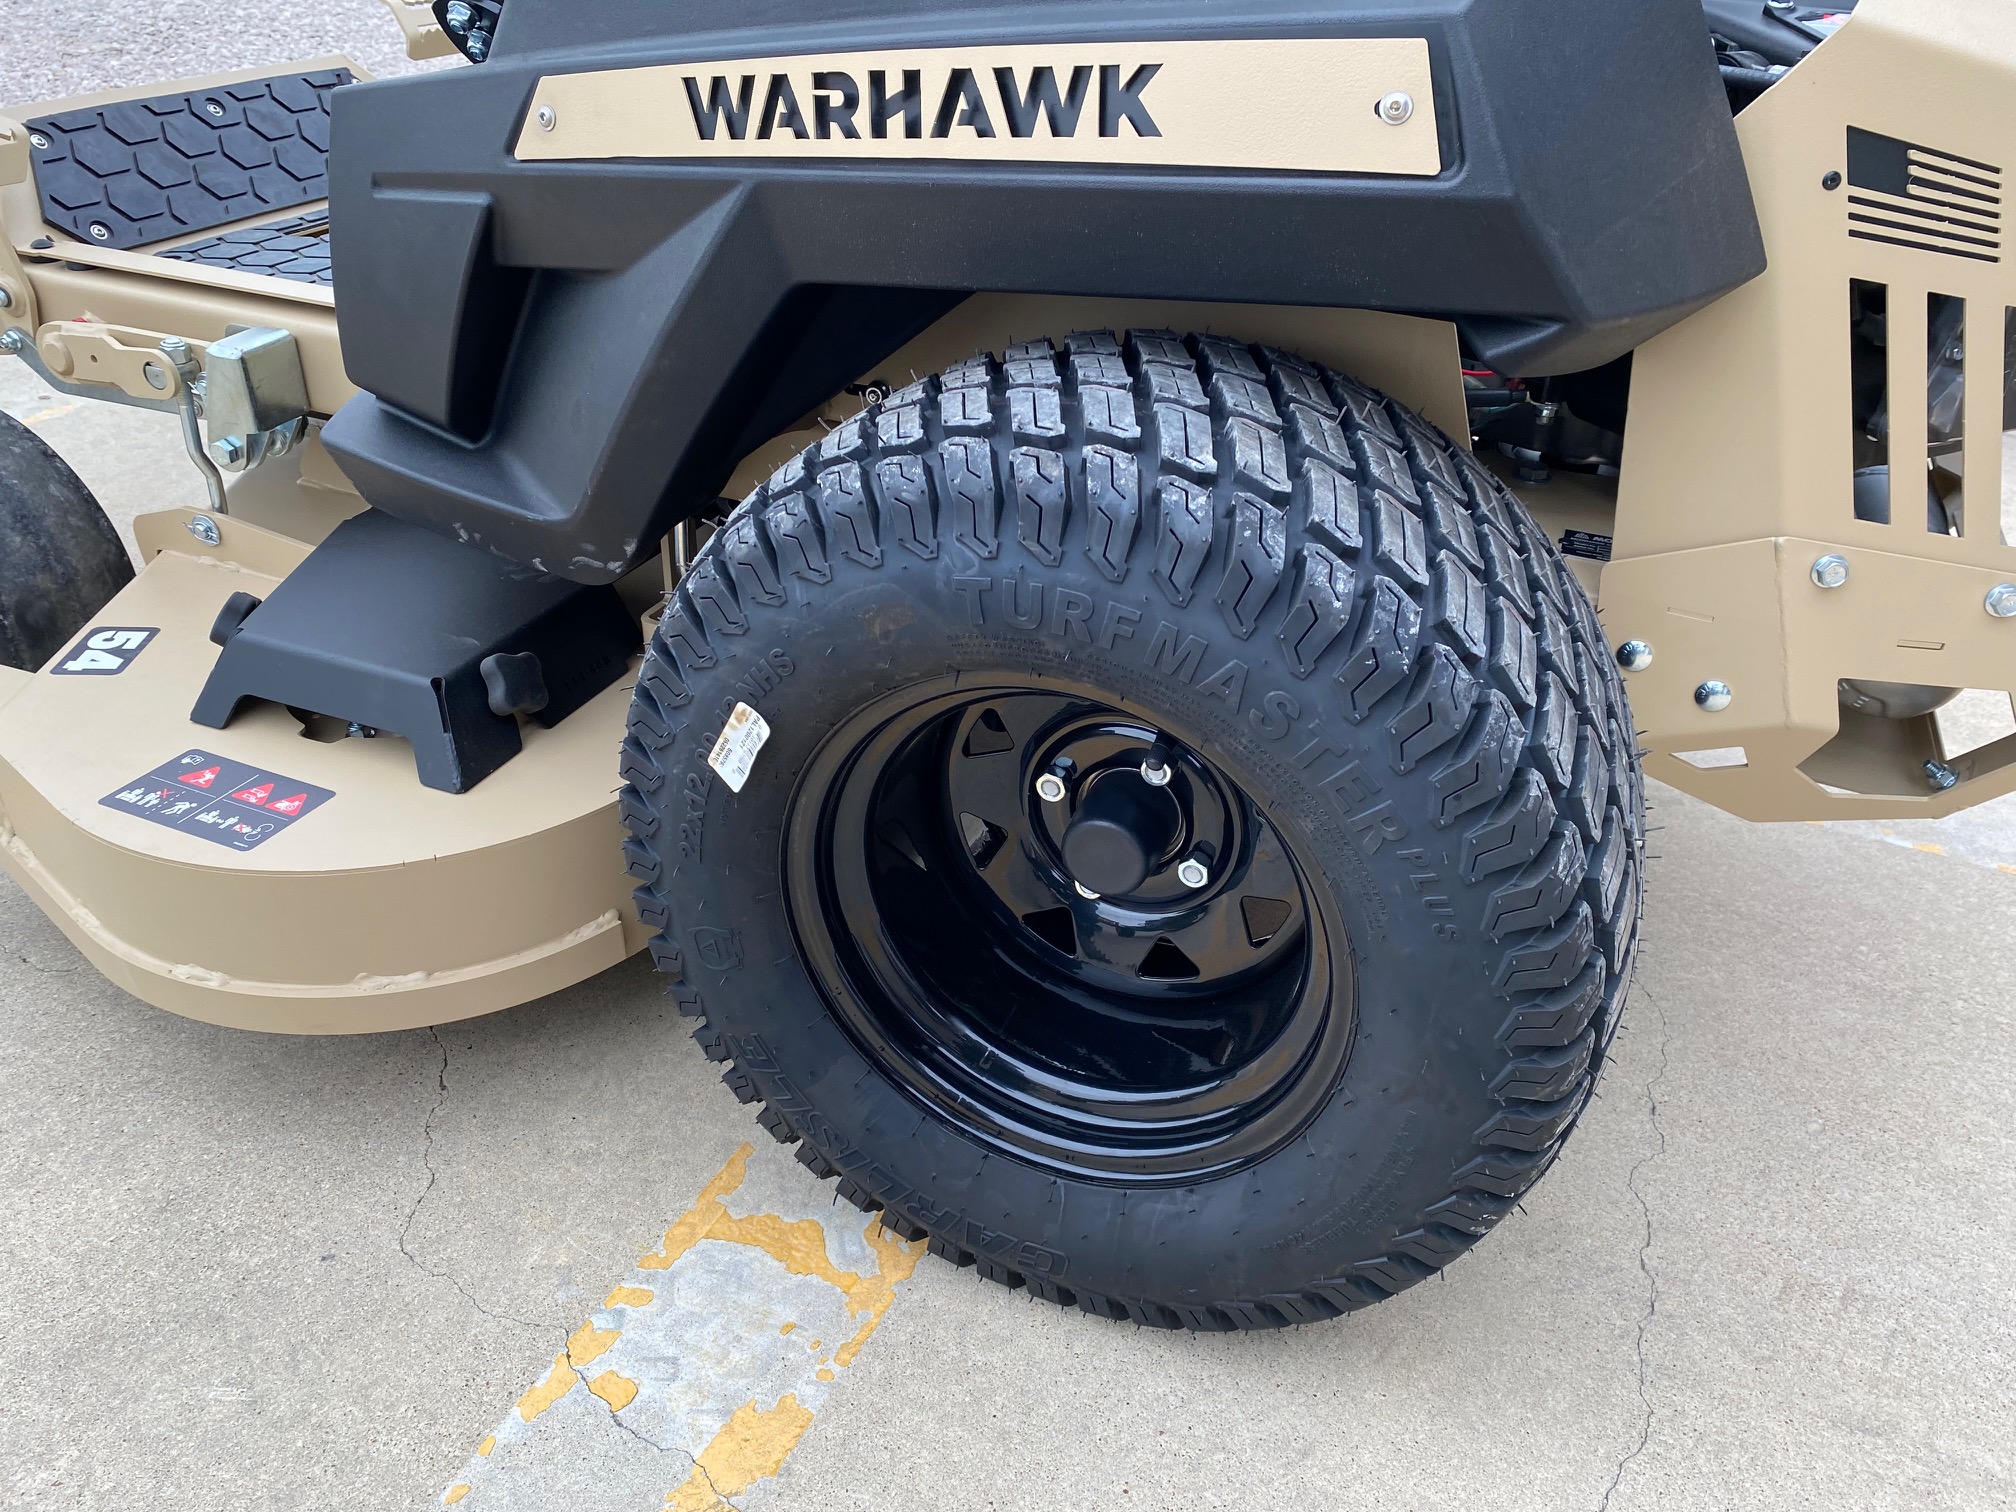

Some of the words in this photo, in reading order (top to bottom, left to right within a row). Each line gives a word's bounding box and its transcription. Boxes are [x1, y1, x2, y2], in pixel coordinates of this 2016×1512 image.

[681, 63, 1163, 141] WARHAWK
[62, 629, 151, 672] 54
[735, 648, 796, 707] NHS
[953, 576, 1410, 856] TURFMASTER
[1396, 846, 1463, 945] PLUS
[727, 1032, 1070, 1278] CARLISLE
